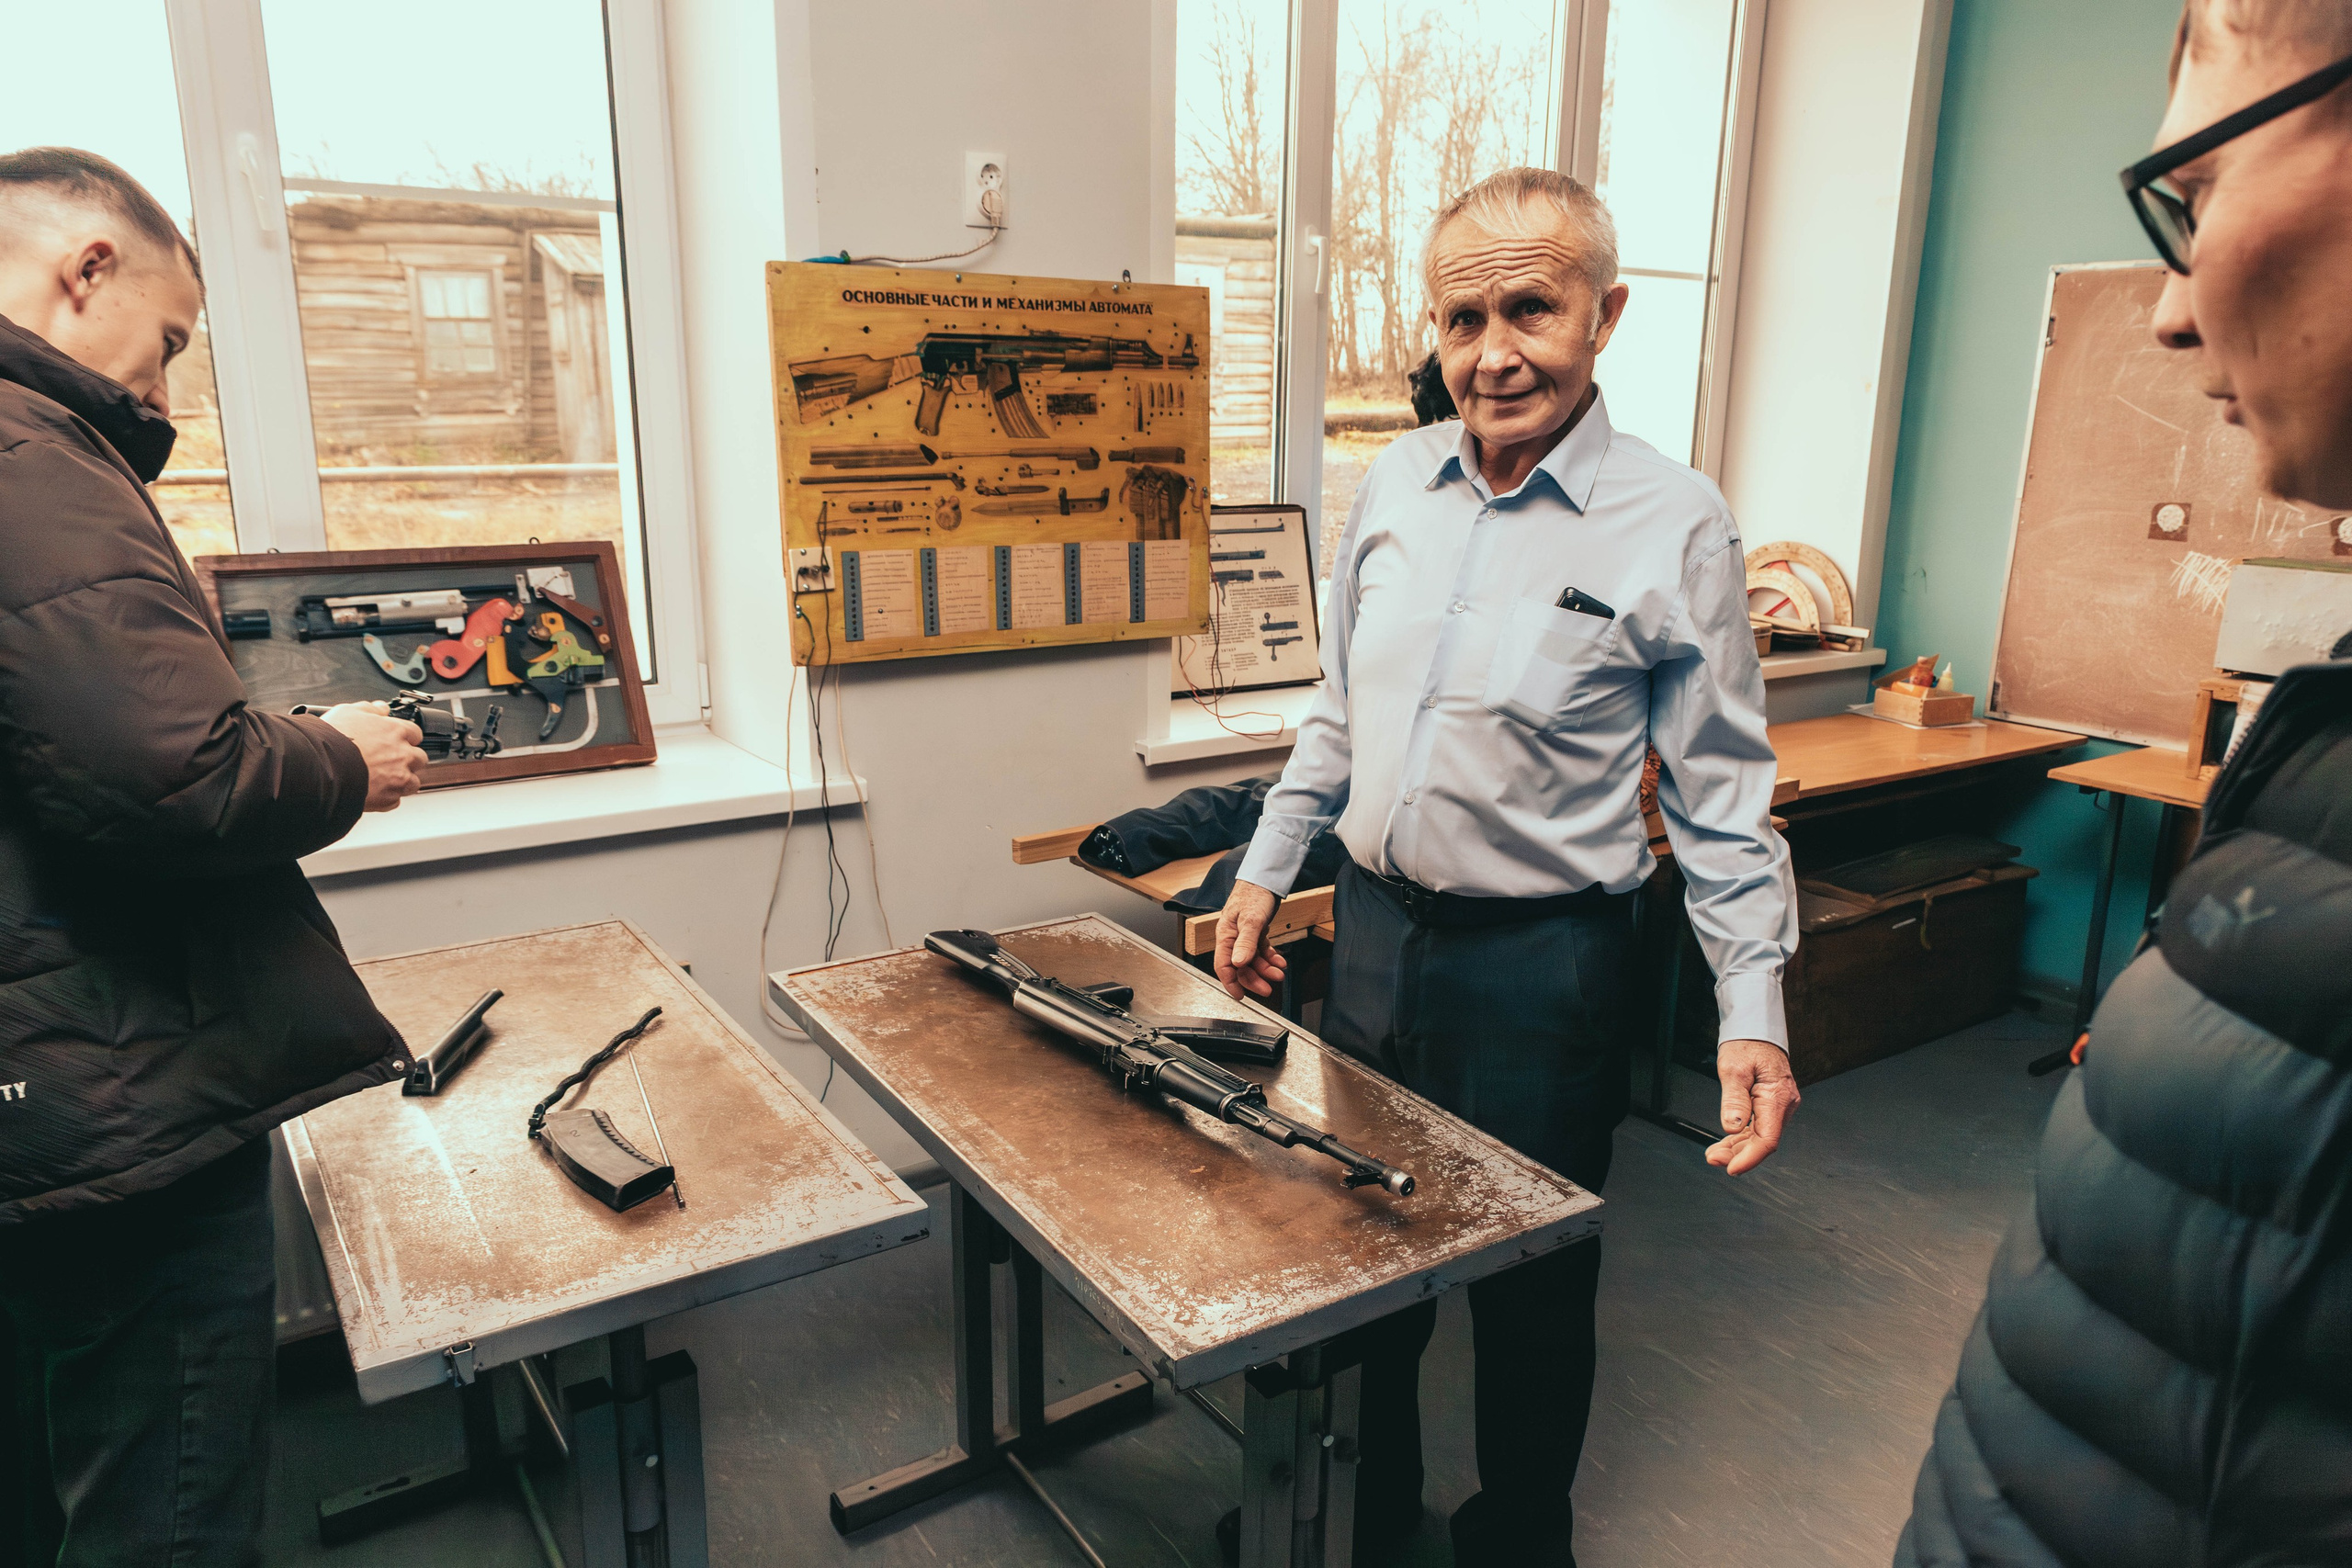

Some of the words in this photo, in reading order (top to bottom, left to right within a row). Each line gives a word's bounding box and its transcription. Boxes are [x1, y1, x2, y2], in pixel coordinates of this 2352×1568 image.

[842, 289, 930, 306] ОСНОВНЫЕ
[932, 294, 978, 309] ЧАСТИ
[982, 297, 992, 309] И
[997, 297, 1086, 312] МЕХАНИЗМЫ
[1089, 300, 1153, 315] АВТОМАТА
